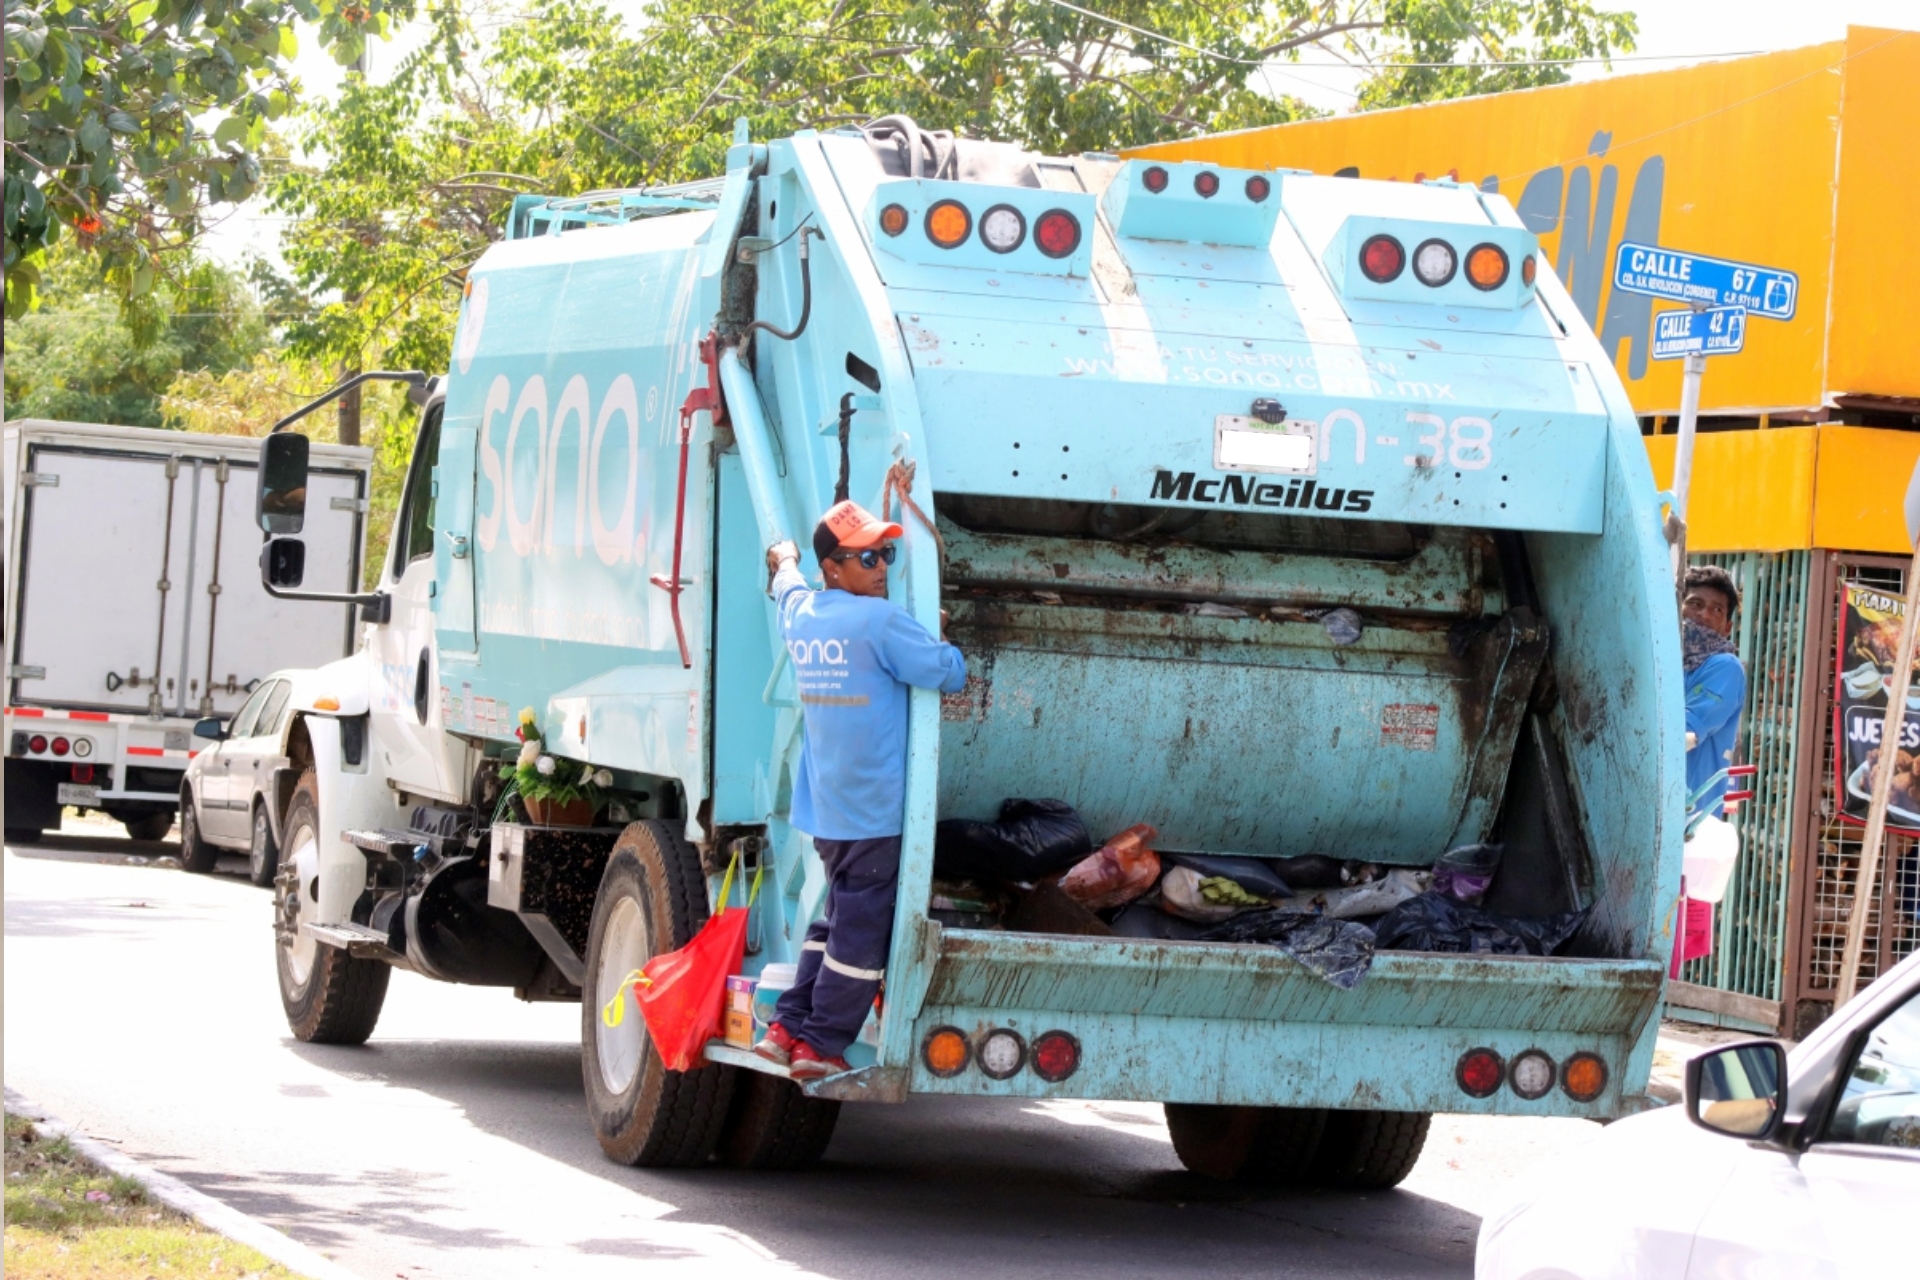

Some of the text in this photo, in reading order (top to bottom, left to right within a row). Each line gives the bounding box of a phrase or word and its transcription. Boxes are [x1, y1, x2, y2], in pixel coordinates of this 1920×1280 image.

[1631, 250, 1757, 294] CALLE 67
[1660, 312, 1724, 339] CALLE 42
[1064, 356, 1457, 400] www.sana.com.mx
[1225, 349, 1354, 373] SERVICIO
[1150, 469, 1375, 513] McNeilus
[1849, 716, 1920, 748] JUEES
